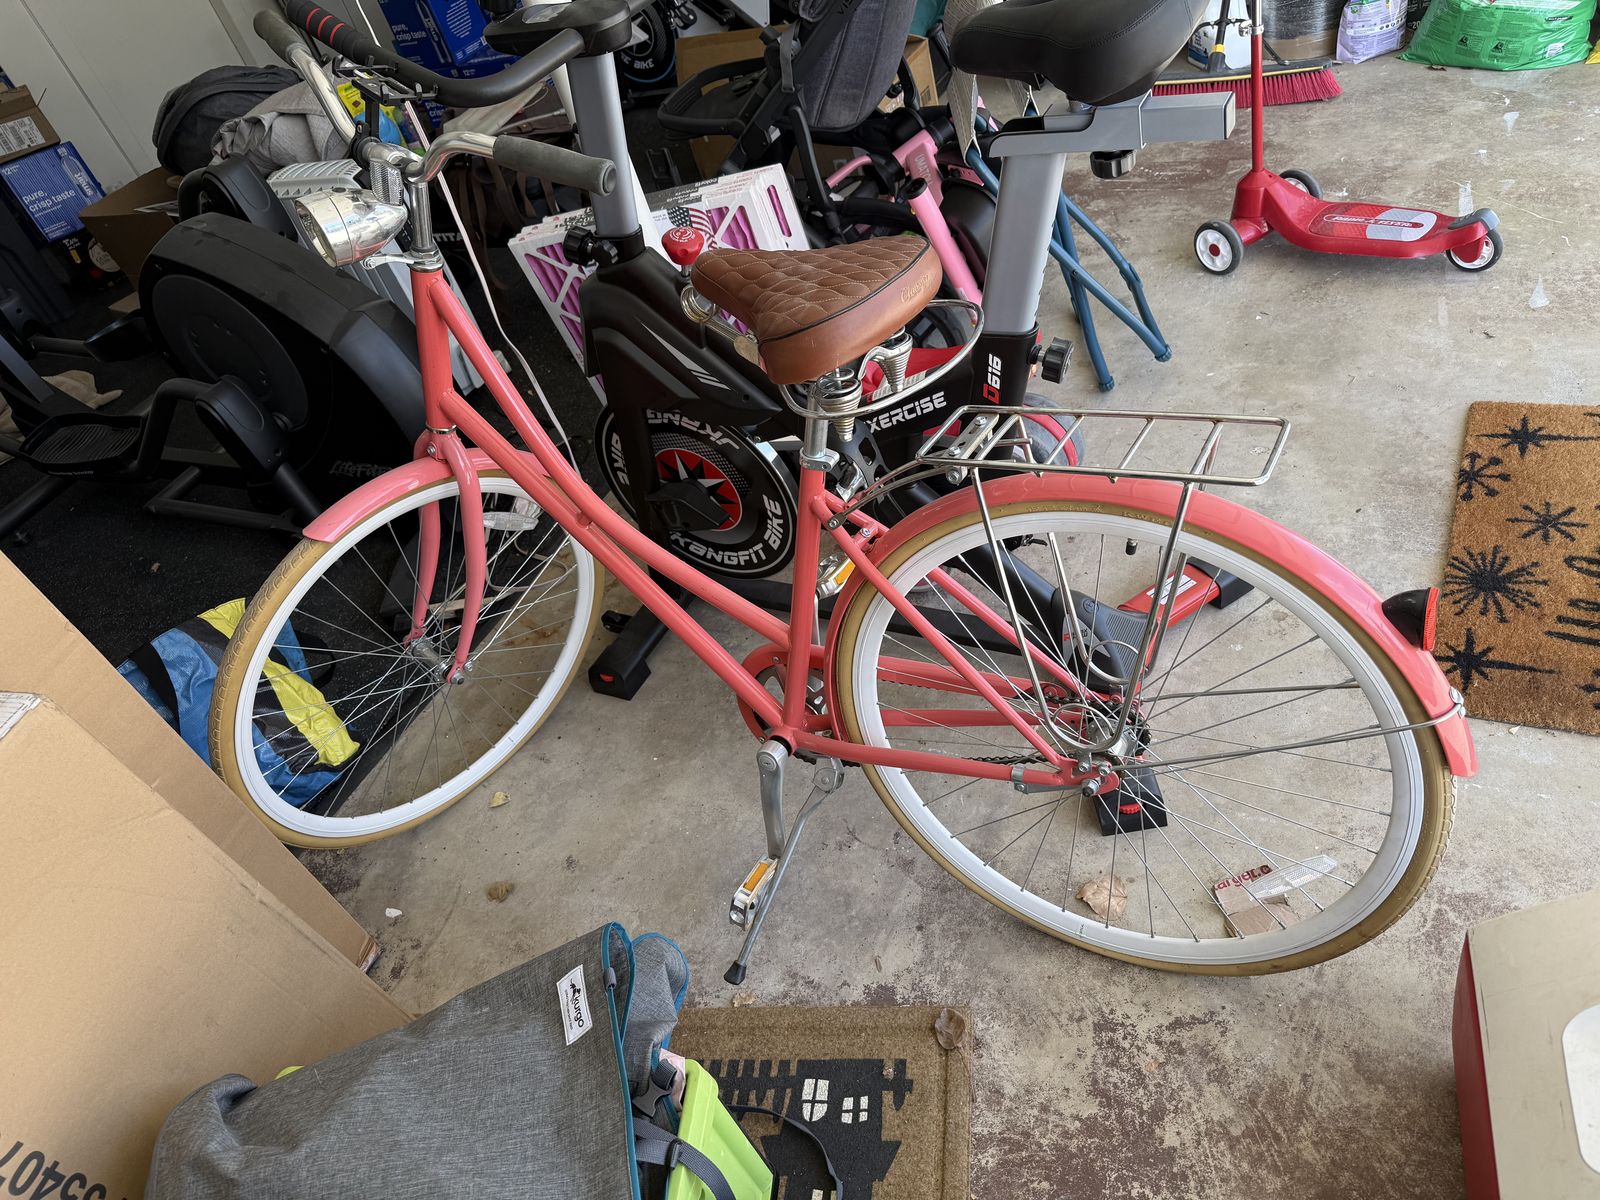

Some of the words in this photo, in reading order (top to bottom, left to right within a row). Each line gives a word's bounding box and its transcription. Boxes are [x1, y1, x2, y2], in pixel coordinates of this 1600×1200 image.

[22, 189, 48, 205] pure,
[28, 196, 53, 213] crisp
[51, 188, 76, 204] taste
[864, 391, 947, 433] XERCISE
[611, 432, 630, 486] BIKE
[762, 494, 784, 550] BIKE
[669, 529, 767, 566] KANGFIT
[574, 994, 584, 1028] kurgo
